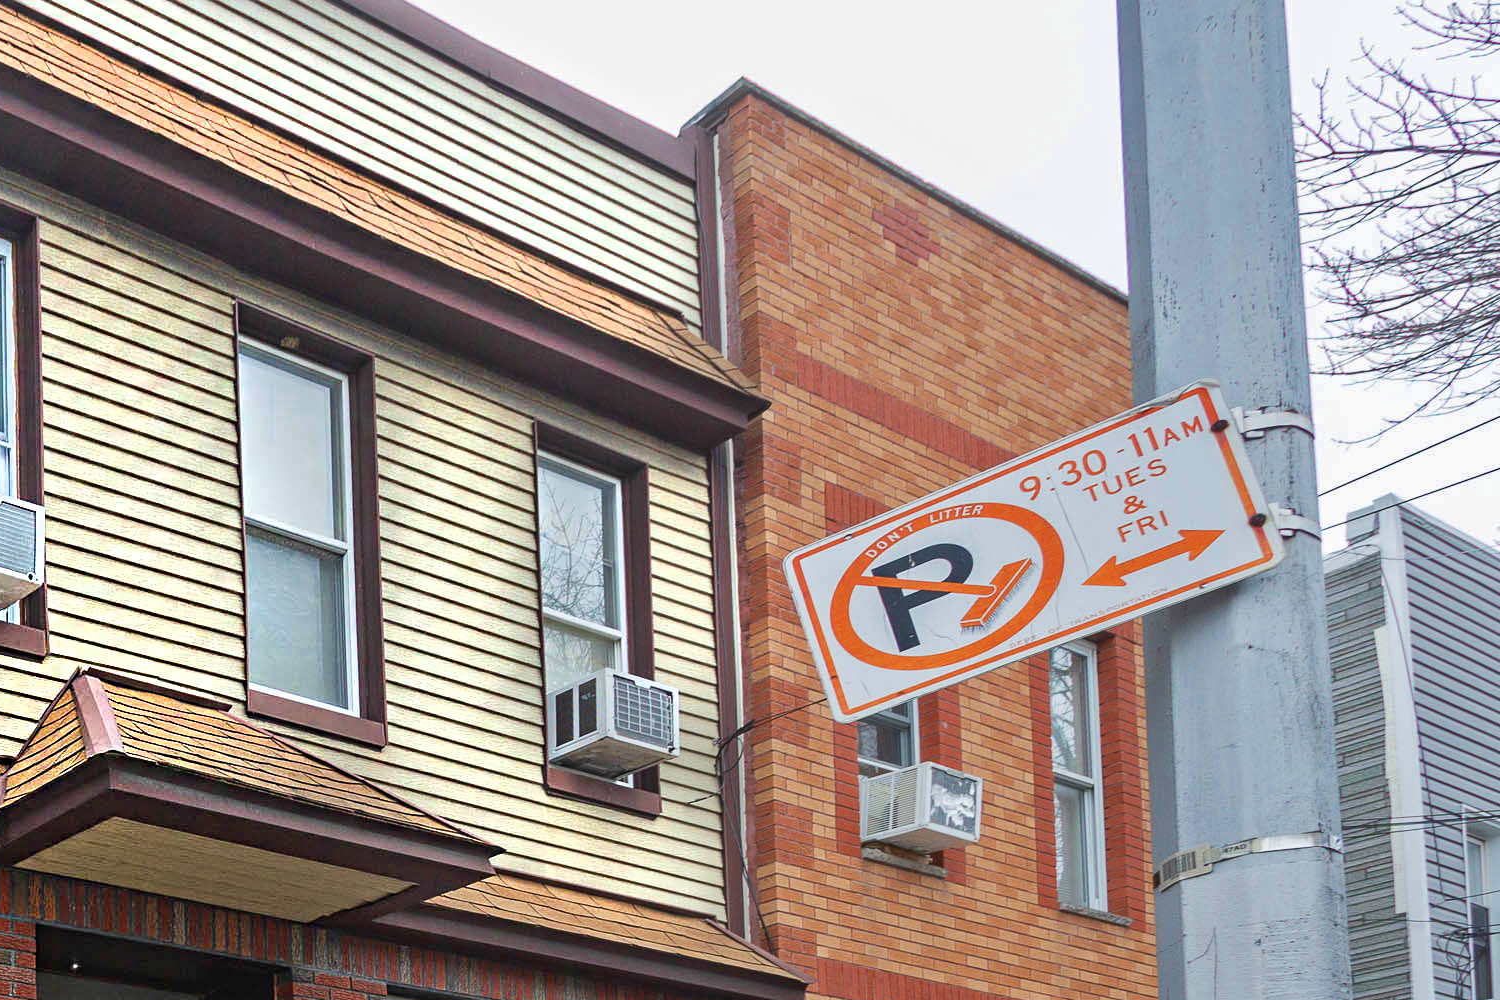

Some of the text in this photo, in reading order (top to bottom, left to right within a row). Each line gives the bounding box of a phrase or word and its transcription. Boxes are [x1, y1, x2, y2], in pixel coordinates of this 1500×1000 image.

[1082, 458, 1167, 502] TUES
[1123, 495, 1148, 515] &
[865, 504, 984, 558] DON'T LITTER
[1117, 510, 1169, 543] FRI
